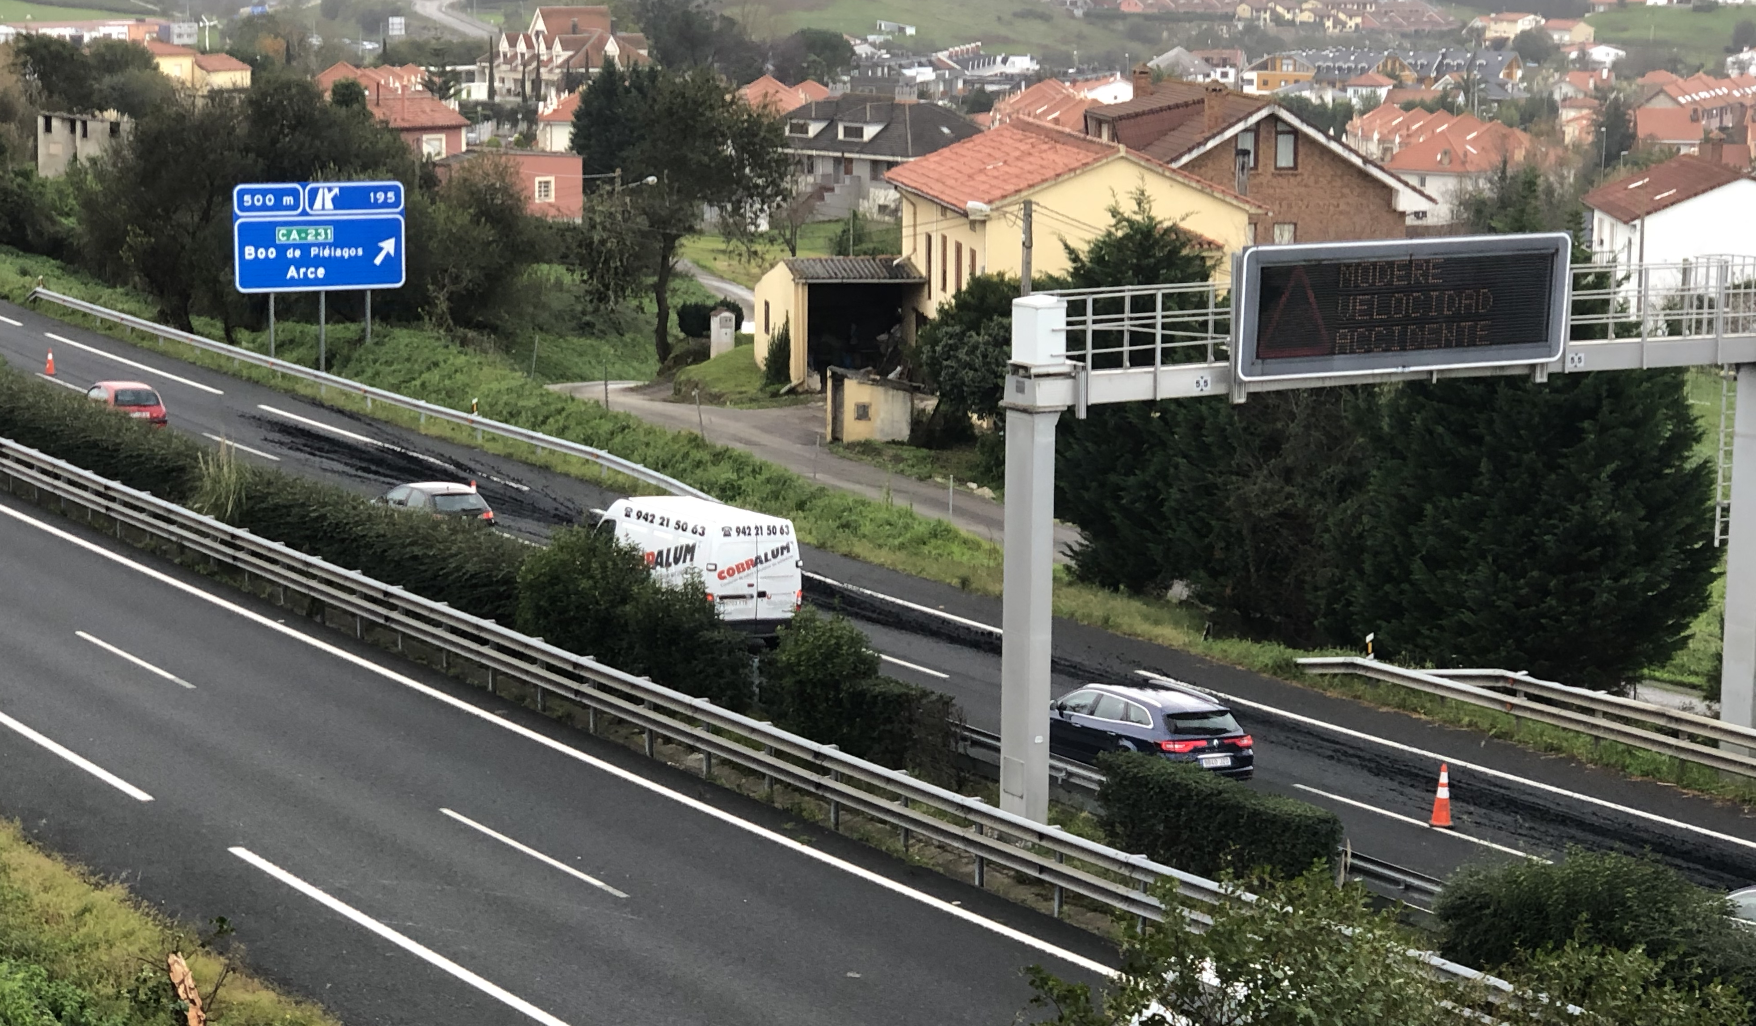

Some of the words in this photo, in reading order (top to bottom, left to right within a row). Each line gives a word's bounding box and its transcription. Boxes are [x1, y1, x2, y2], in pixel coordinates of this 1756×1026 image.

[243, 194, 275, 206] 500
[282, 195, 294, 206] m
[369, 191, 396, 204] 195
[278, 229, 332, 241] CA-231
[244, 246, 277, 260] Boo
[286, 247, 301, 258] de
[310, 245, 364, 259] Piélagos
[286, 265, 326, 280] Arce
[1339, 258, 1445, 288] MODERE
[1338, 289, 1493, 321] VELOCIDAD
[1335, 321, 1492, 354] ACCIDENTE
[636, 509, 656, 524] 942
[658, 516, 671, 528] 21
[674, 520, 688, 532] 50
[691, 524, 706, 537] 63
[735, 525, 752, 537] 942
[754, 525, 763, 536] 21
[766, 525, 778, 536] 50
[779, 524, 790, 536] 63
[717, 541, 792, 581] COBRALUM
